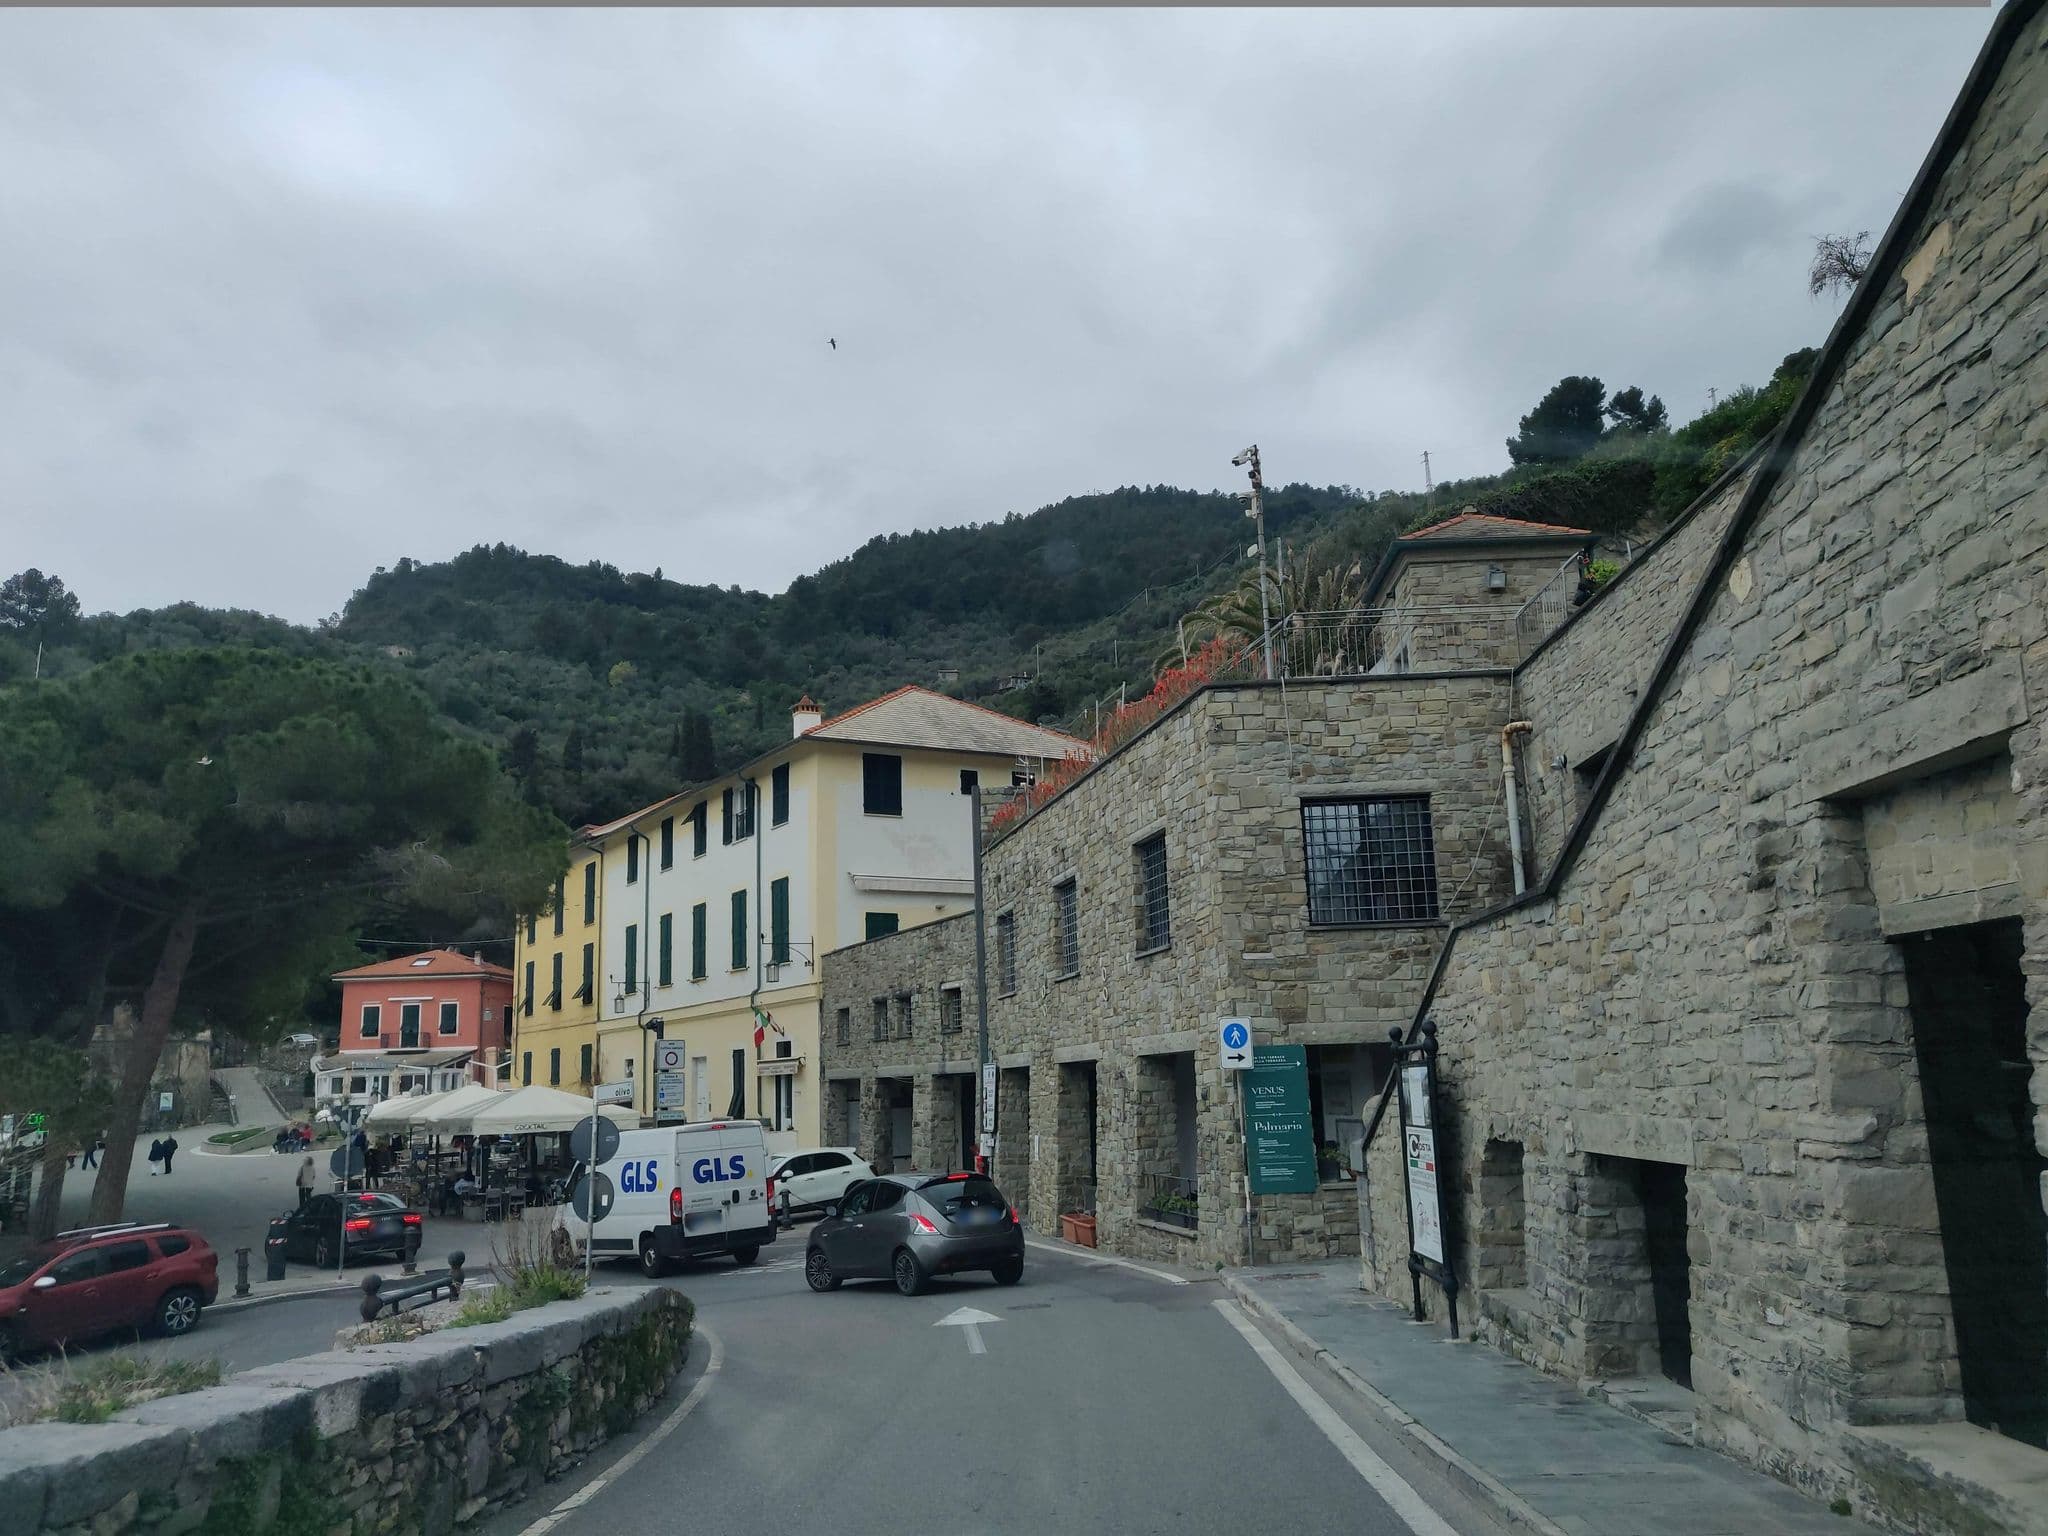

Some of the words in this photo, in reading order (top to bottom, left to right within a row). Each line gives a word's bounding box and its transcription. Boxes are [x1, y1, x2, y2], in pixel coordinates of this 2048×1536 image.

[1251, 1086, 1285, 1095] VENUS
[1254, 1120, 1302, 1132] Palmaria
[621, 1160, 658, 1193] GLS
[692, 1155, 746, 1184] GLS
